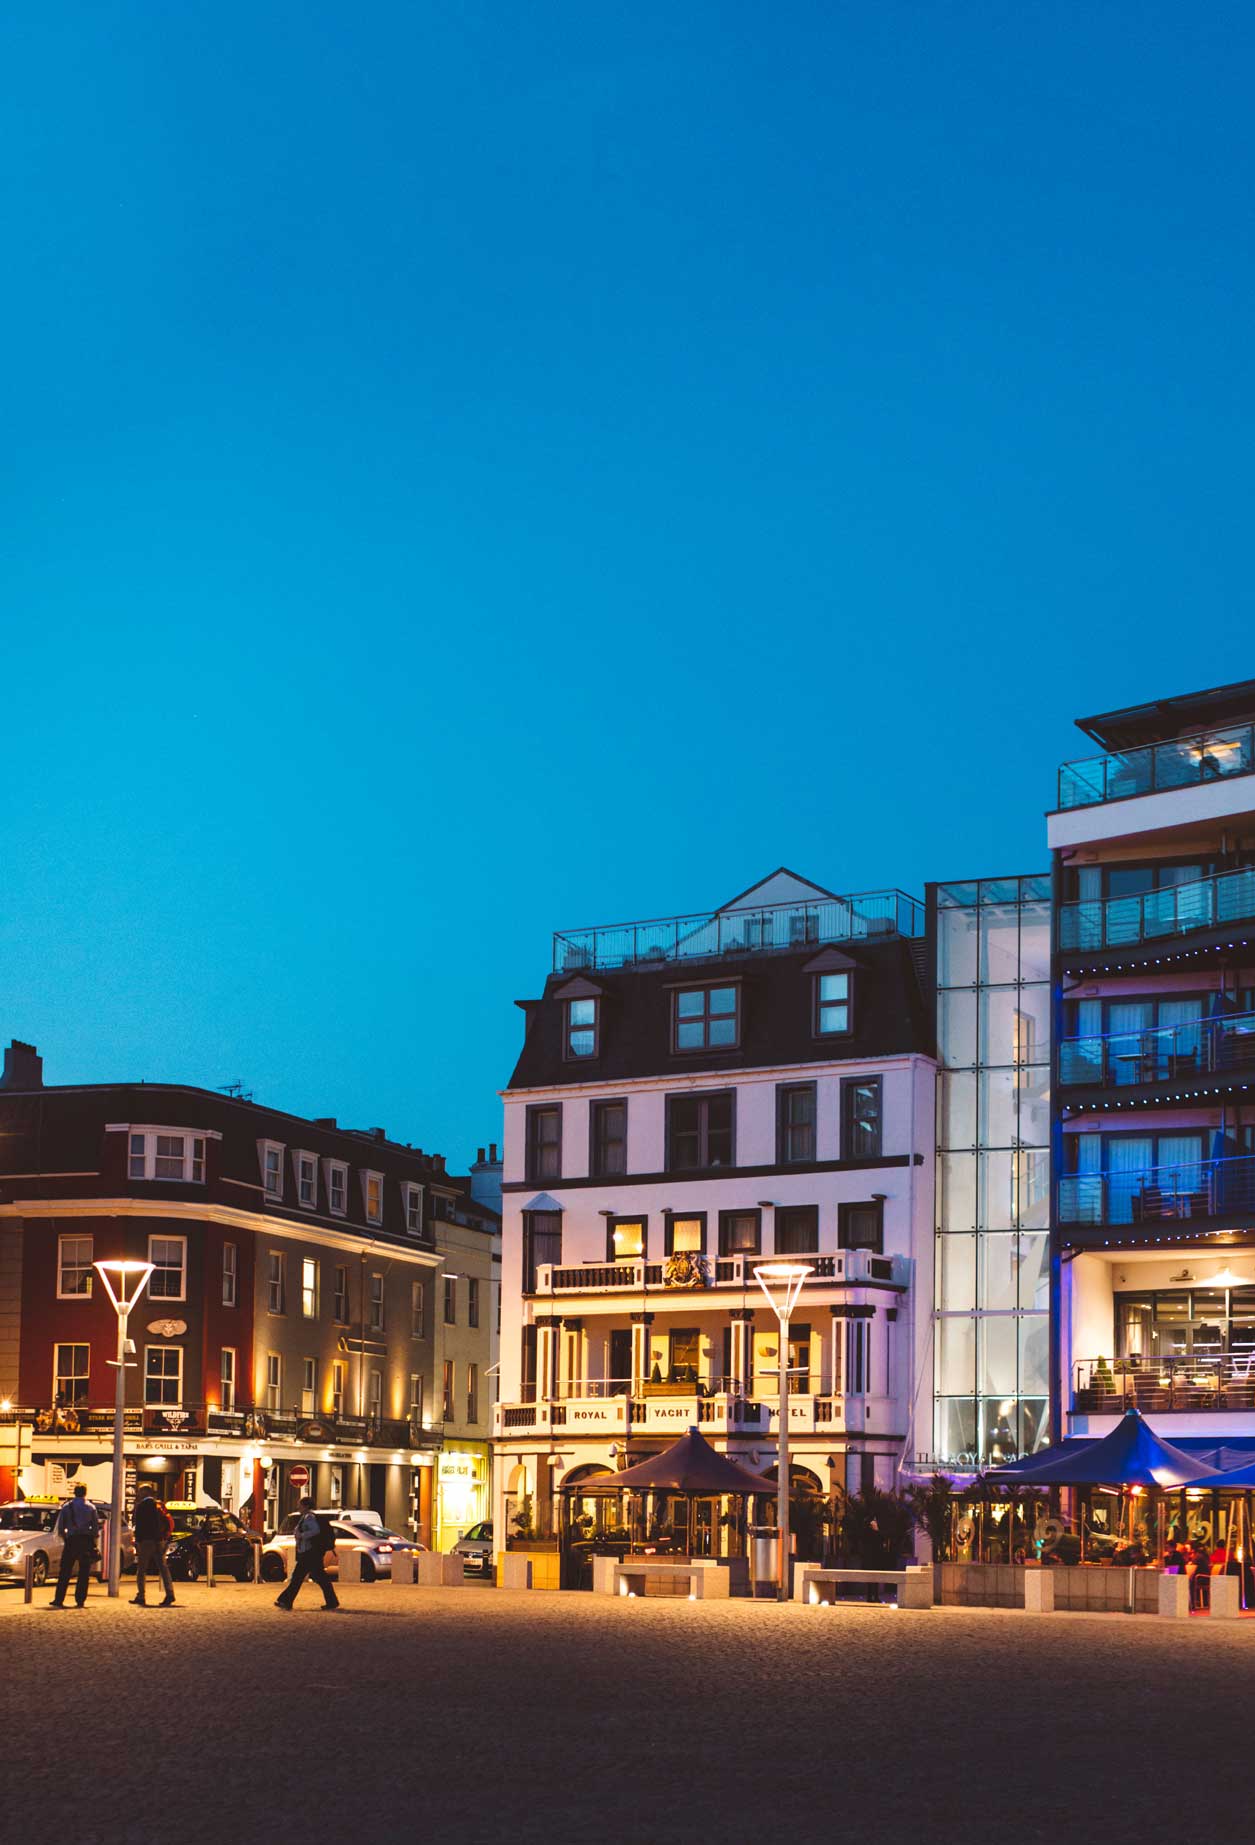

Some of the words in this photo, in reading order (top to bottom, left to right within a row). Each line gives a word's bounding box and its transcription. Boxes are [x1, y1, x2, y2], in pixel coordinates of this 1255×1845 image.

[574, 1411, 607, 1420] ROYAL
[654, 1409, 690, 1418] YACHT
[768, 1408, 807, 1417] HOEL
